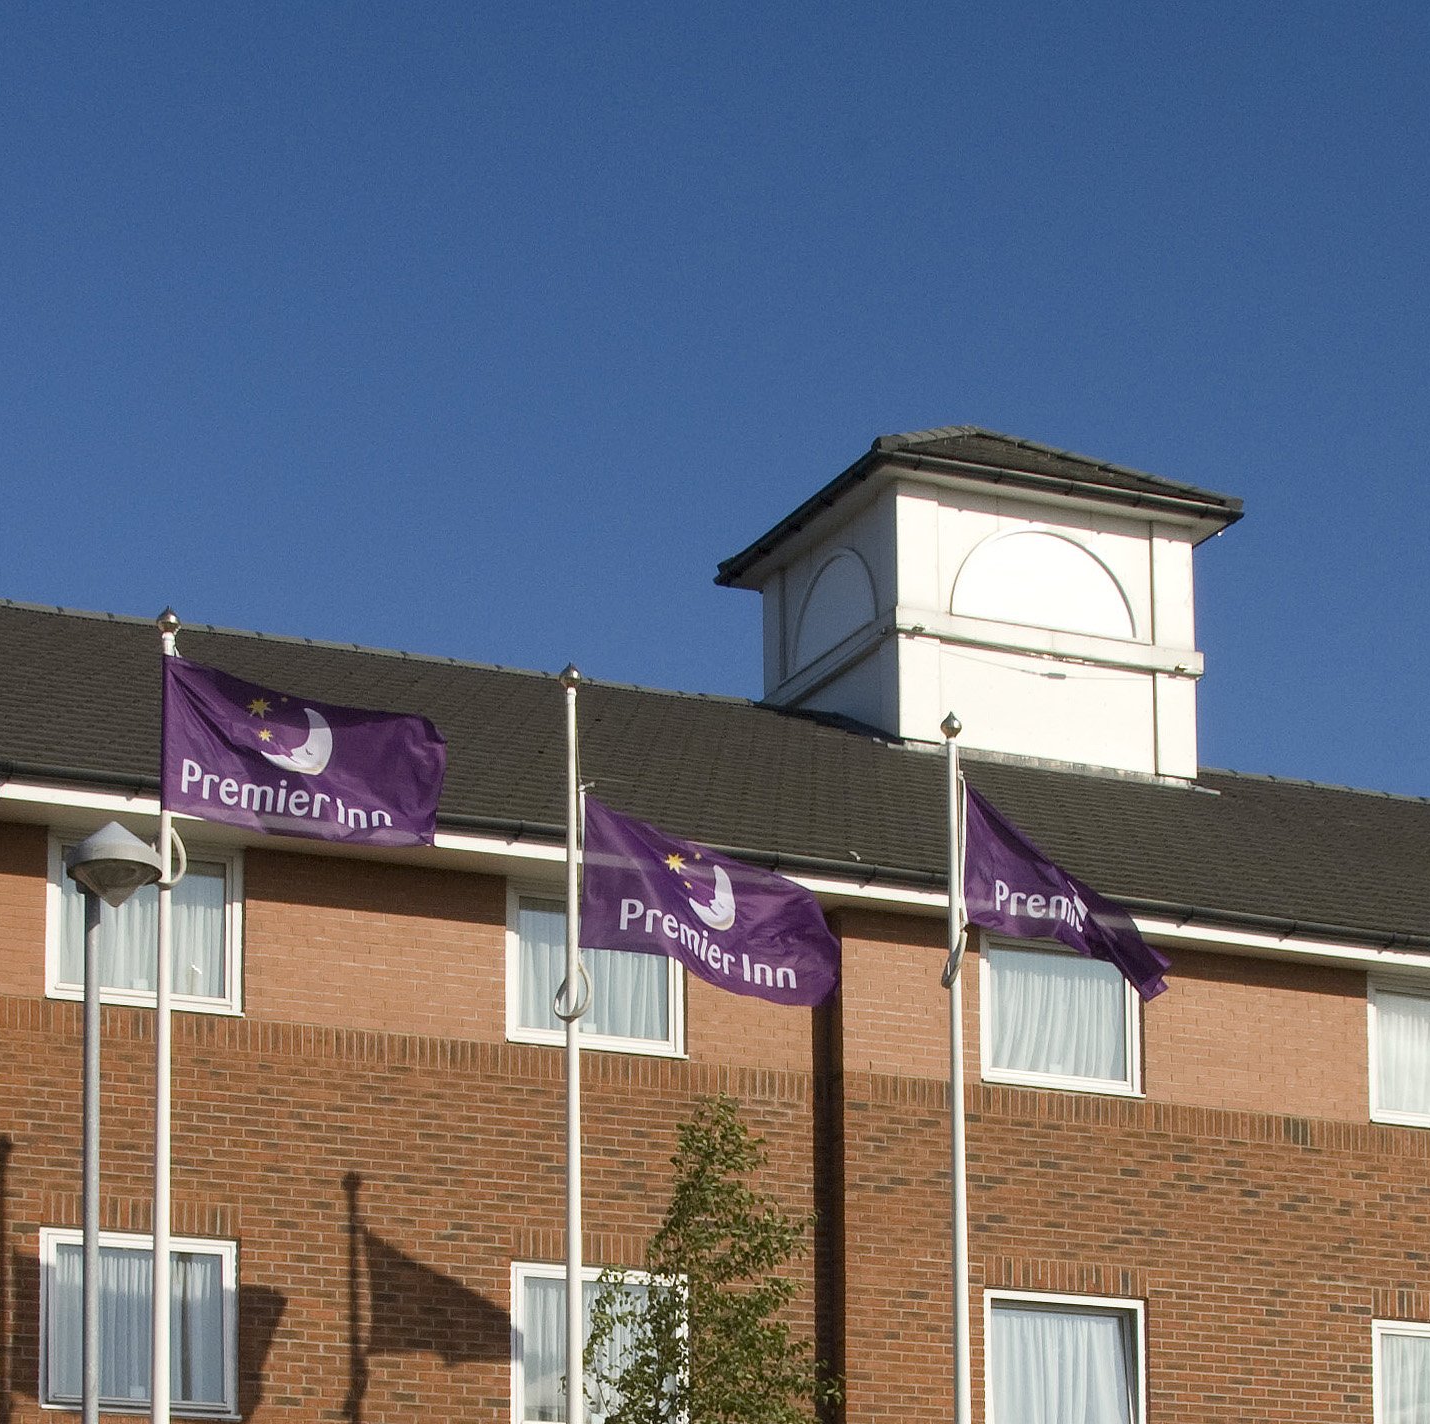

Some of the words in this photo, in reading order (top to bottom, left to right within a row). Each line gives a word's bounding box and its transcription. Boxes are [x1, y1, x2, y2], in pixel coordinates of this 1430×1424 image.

[181, 758, 331, 819] Premier
[336, 798, 393, 829] Inn
[995, 880, 1084, 933] Premi
[619, 898, 736, 975] Premier
[742, 953, 797, 989] Inn
